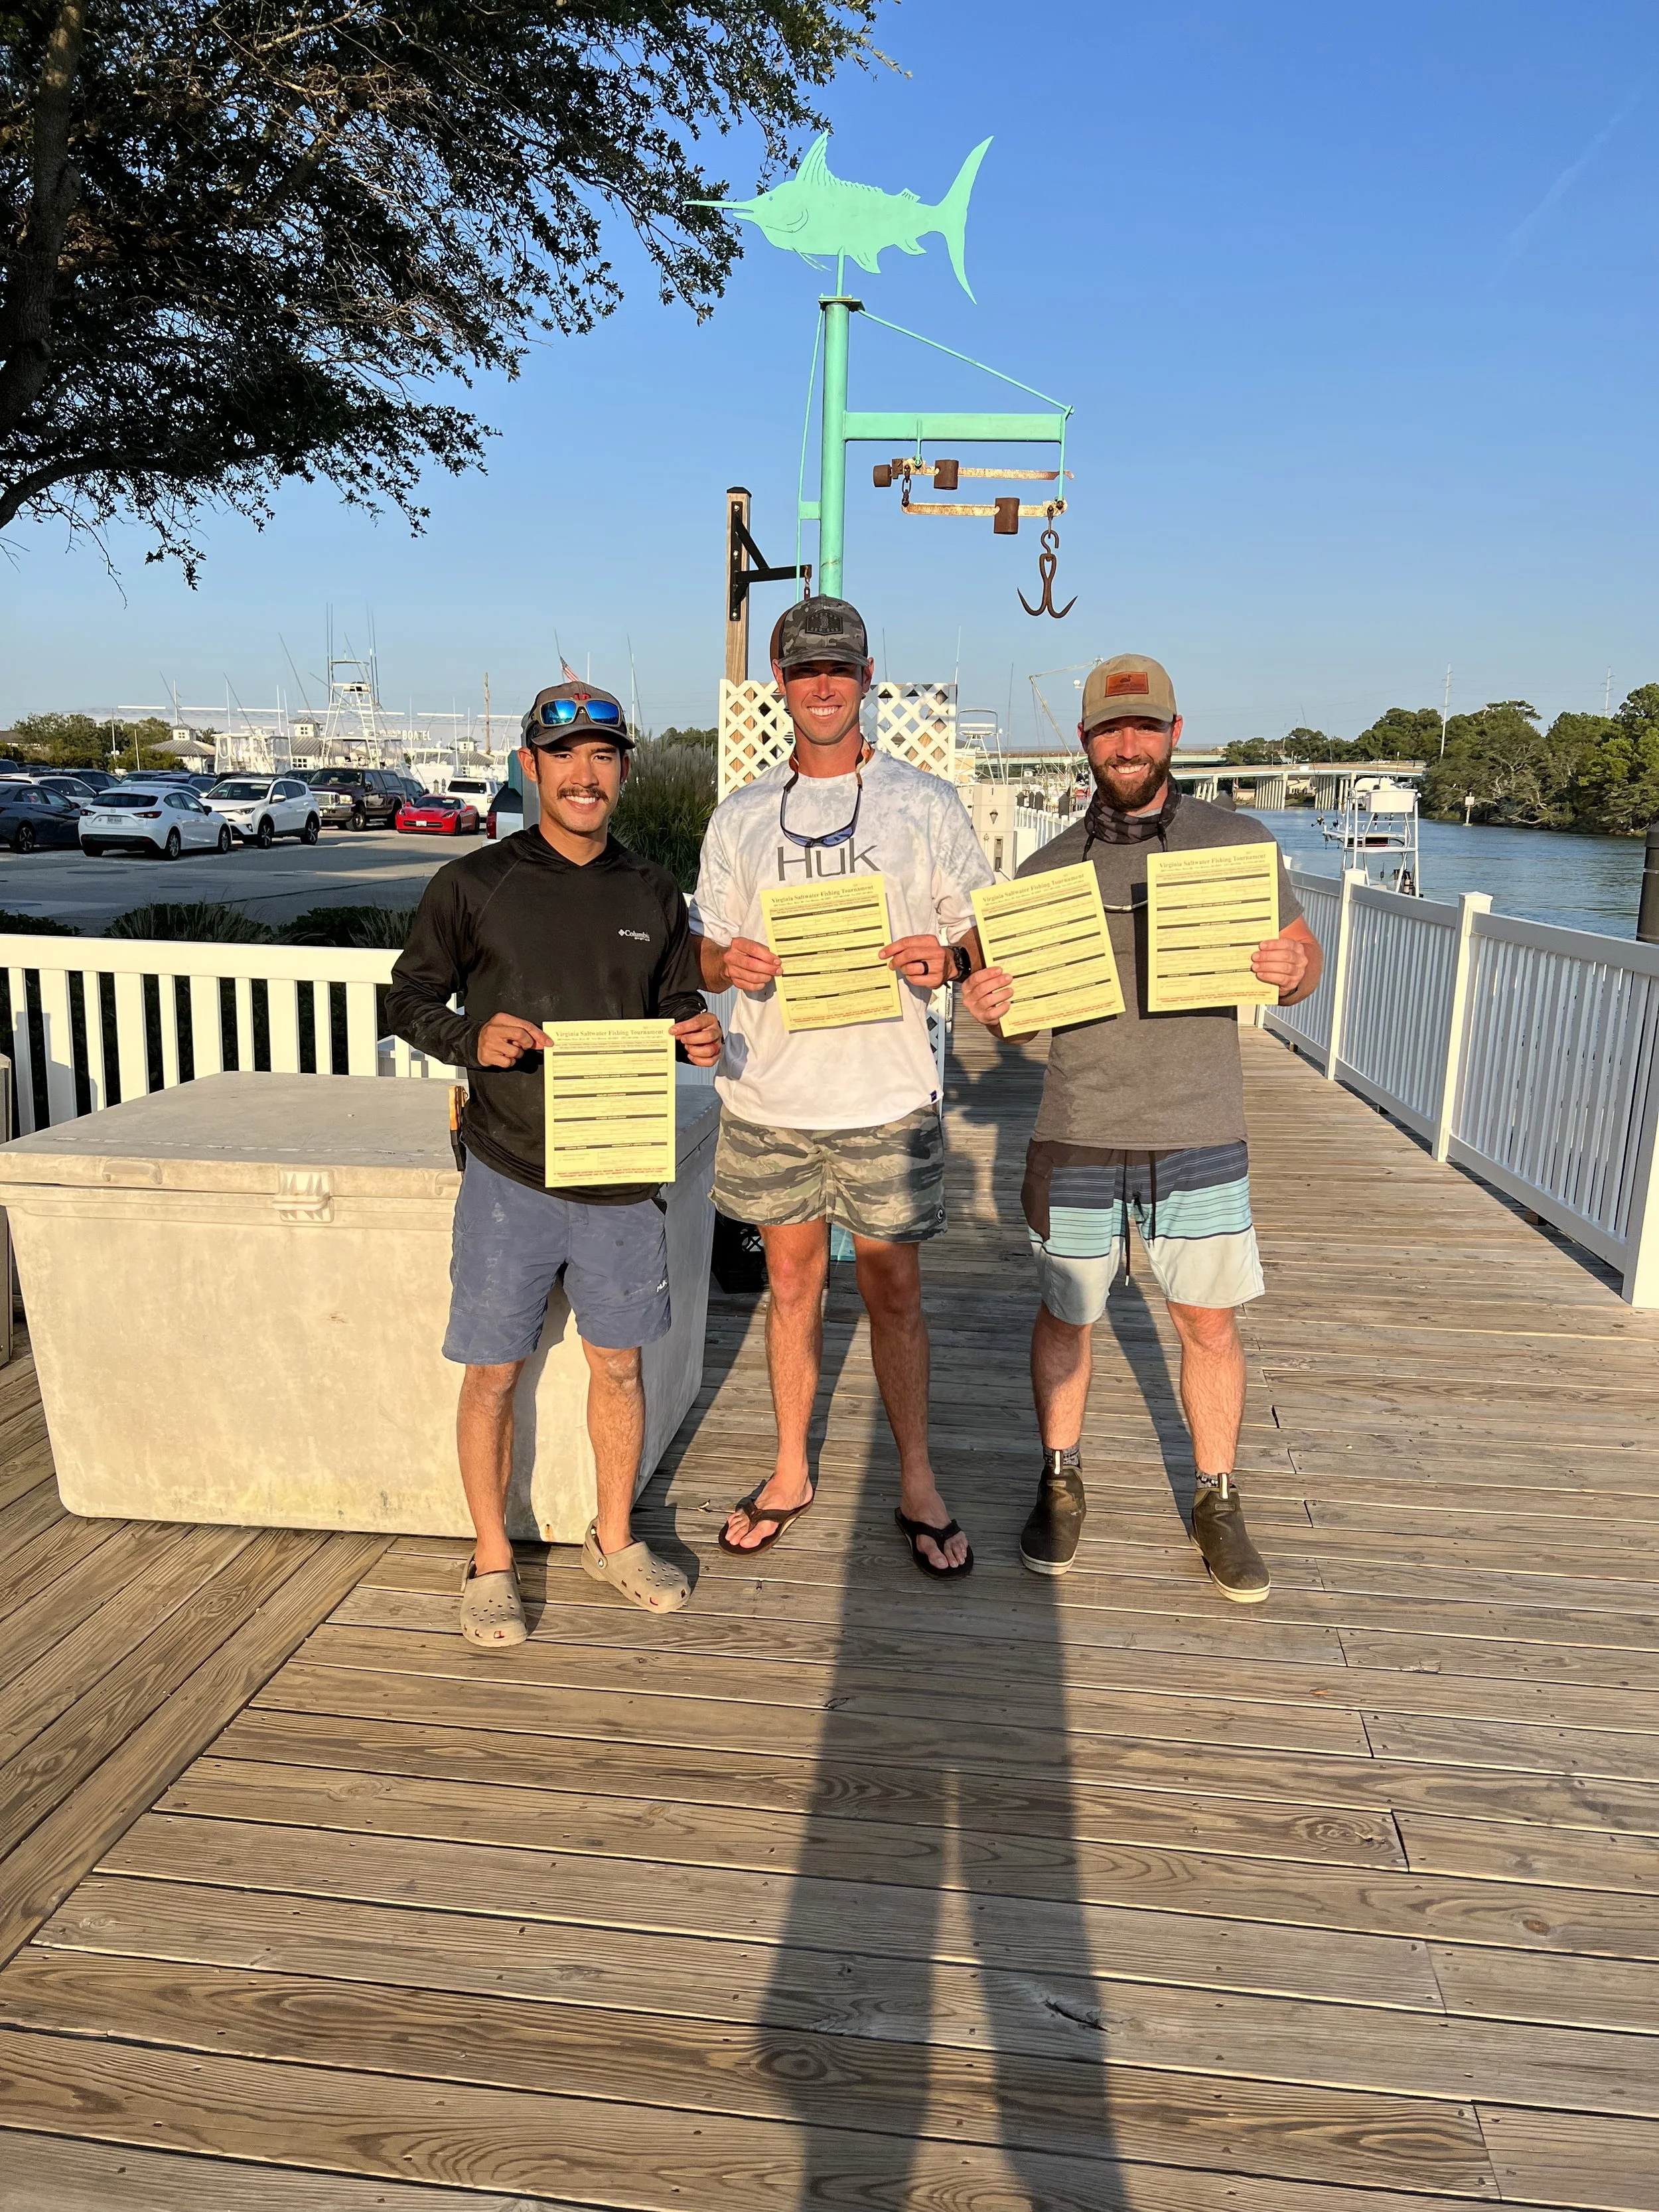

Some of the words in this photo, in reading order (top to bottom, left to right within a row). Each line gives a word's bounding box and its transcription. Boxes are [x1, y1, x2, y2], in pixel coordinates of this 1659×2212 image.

[841, 885, 874, 894] Tournament
[983, 894, 1004, 903] Virginia
[1004, 887, 1029, 897] Saltwater
[1030, 882, 1050, 891] Fishing
